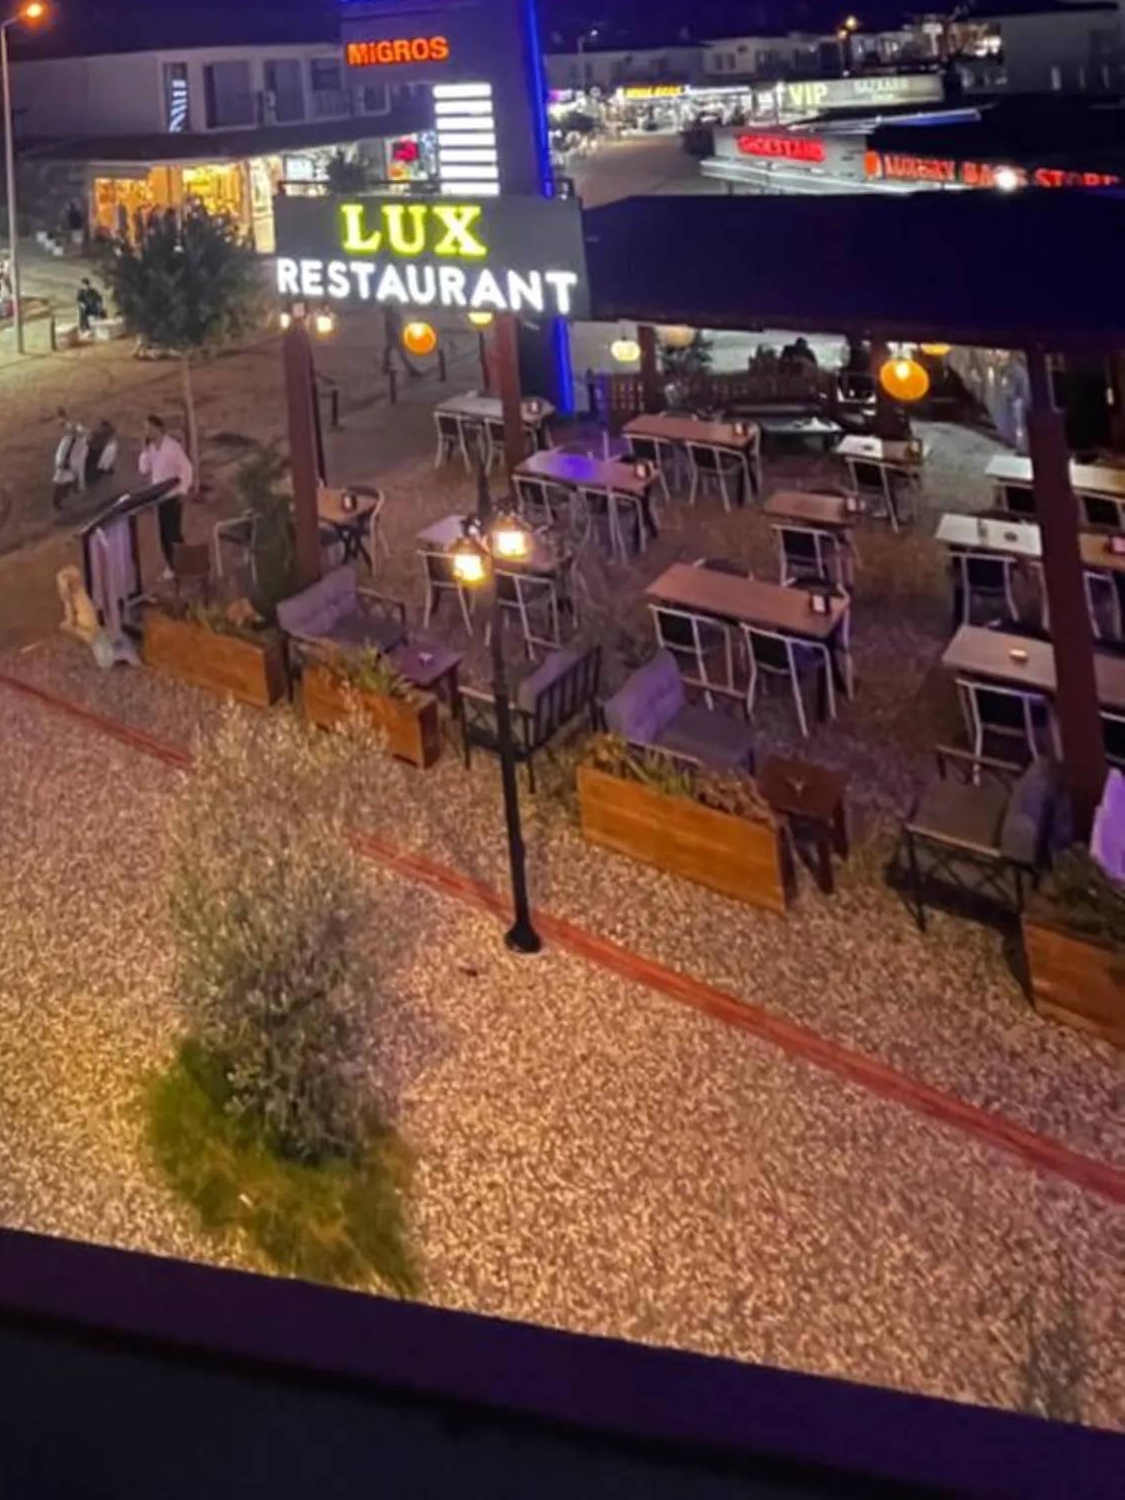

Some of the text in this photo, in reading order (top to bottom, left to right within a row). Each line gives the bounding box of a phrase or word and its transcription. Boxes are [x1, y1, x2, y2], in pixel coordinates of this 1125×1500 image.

[789, 82, 828, 105] VIP
[962, 161, 1028, 188] BAS
[340, 203, 488, 258] LUX
[276, 256, 578, 315] RESTAURANT
